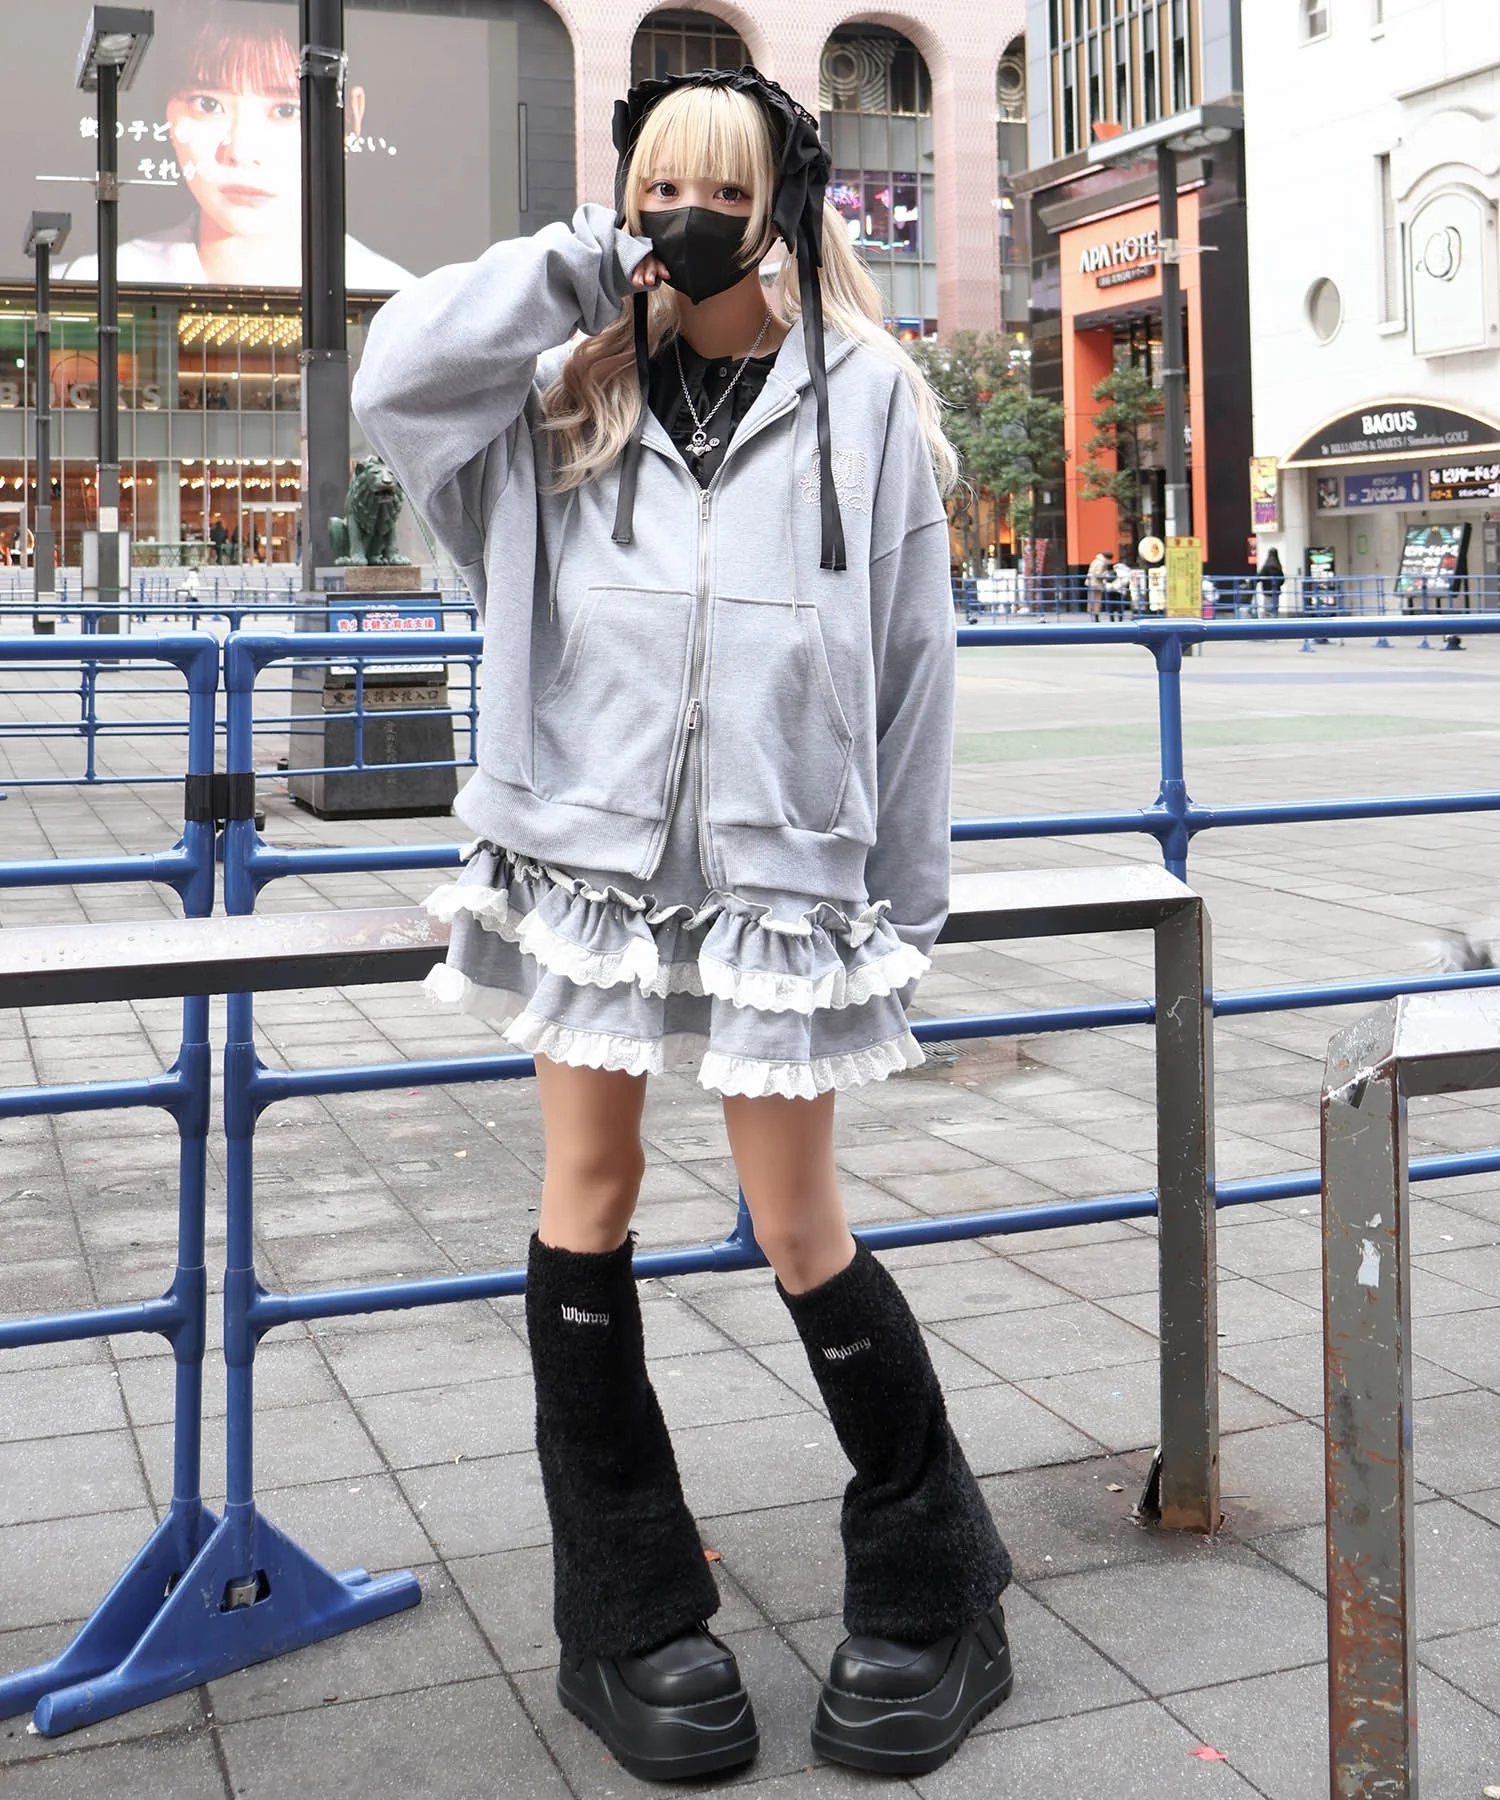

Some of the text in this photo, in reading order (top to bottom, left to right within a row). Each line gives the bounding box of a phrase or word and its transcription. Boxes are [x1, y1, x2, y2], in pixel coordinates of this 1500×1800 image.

[1080, 244, 1111, 273] APA
[1361, 410, 1417, 435] BAGUS
[1445, 430, 1469, 443] GOLF
